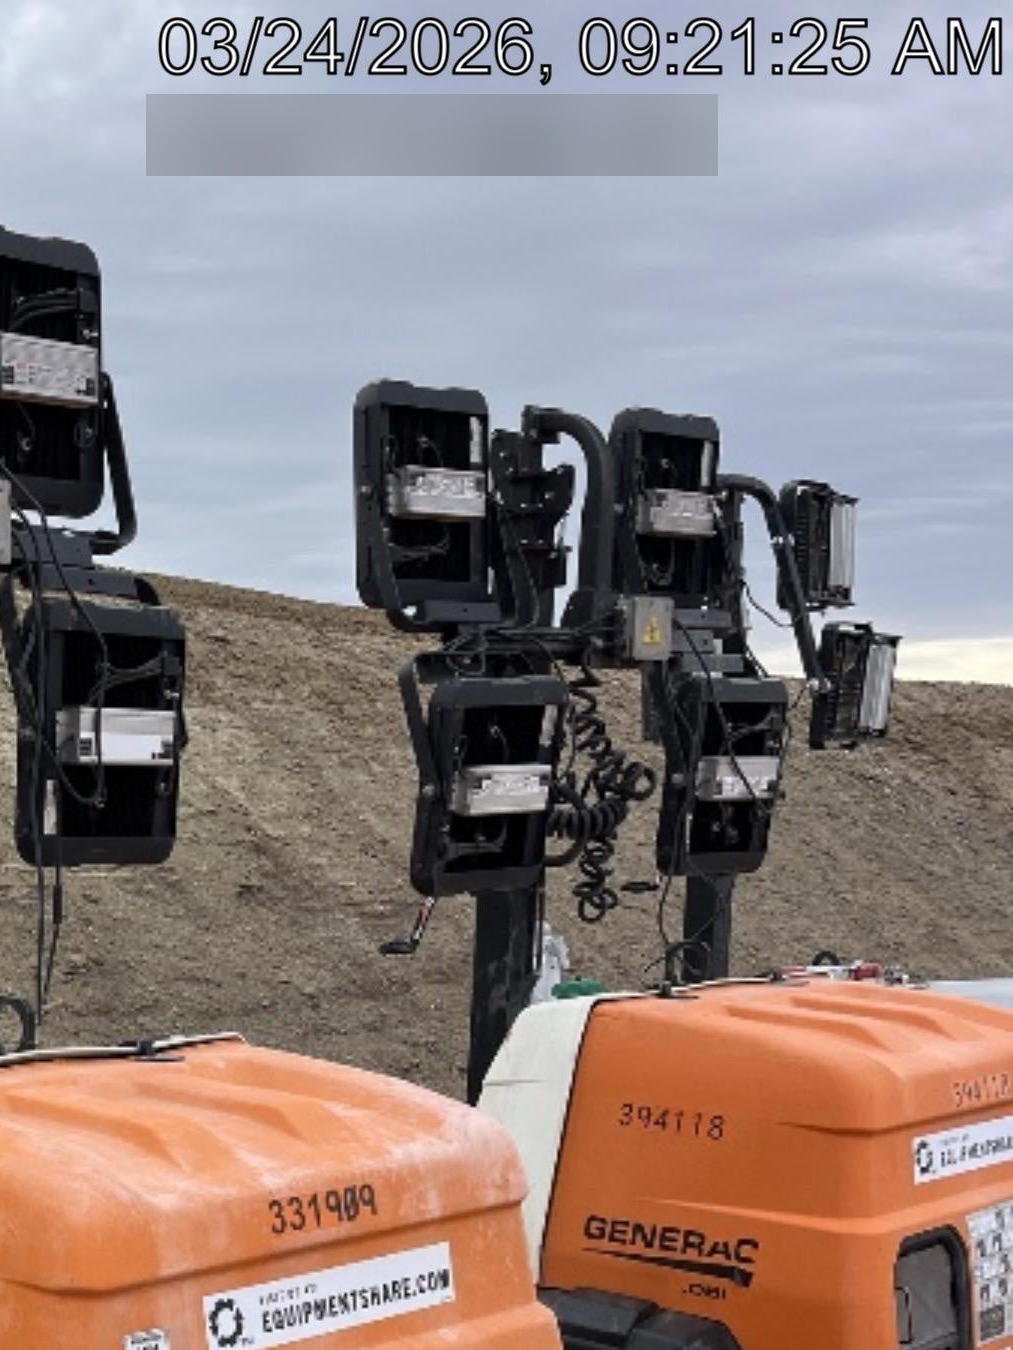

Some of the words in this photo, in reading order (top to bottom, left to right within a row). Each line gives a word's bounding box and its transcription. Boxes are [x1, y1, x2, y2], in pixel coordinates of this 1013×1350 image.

[617, 1103, 726, 1141] 394118
[268, 1183, 378, 1235] 331909
[583, 1214, 760, 1265] GENERAC
[261, 1267, 451, 1334] EQUIPMENTSHARE.COM
